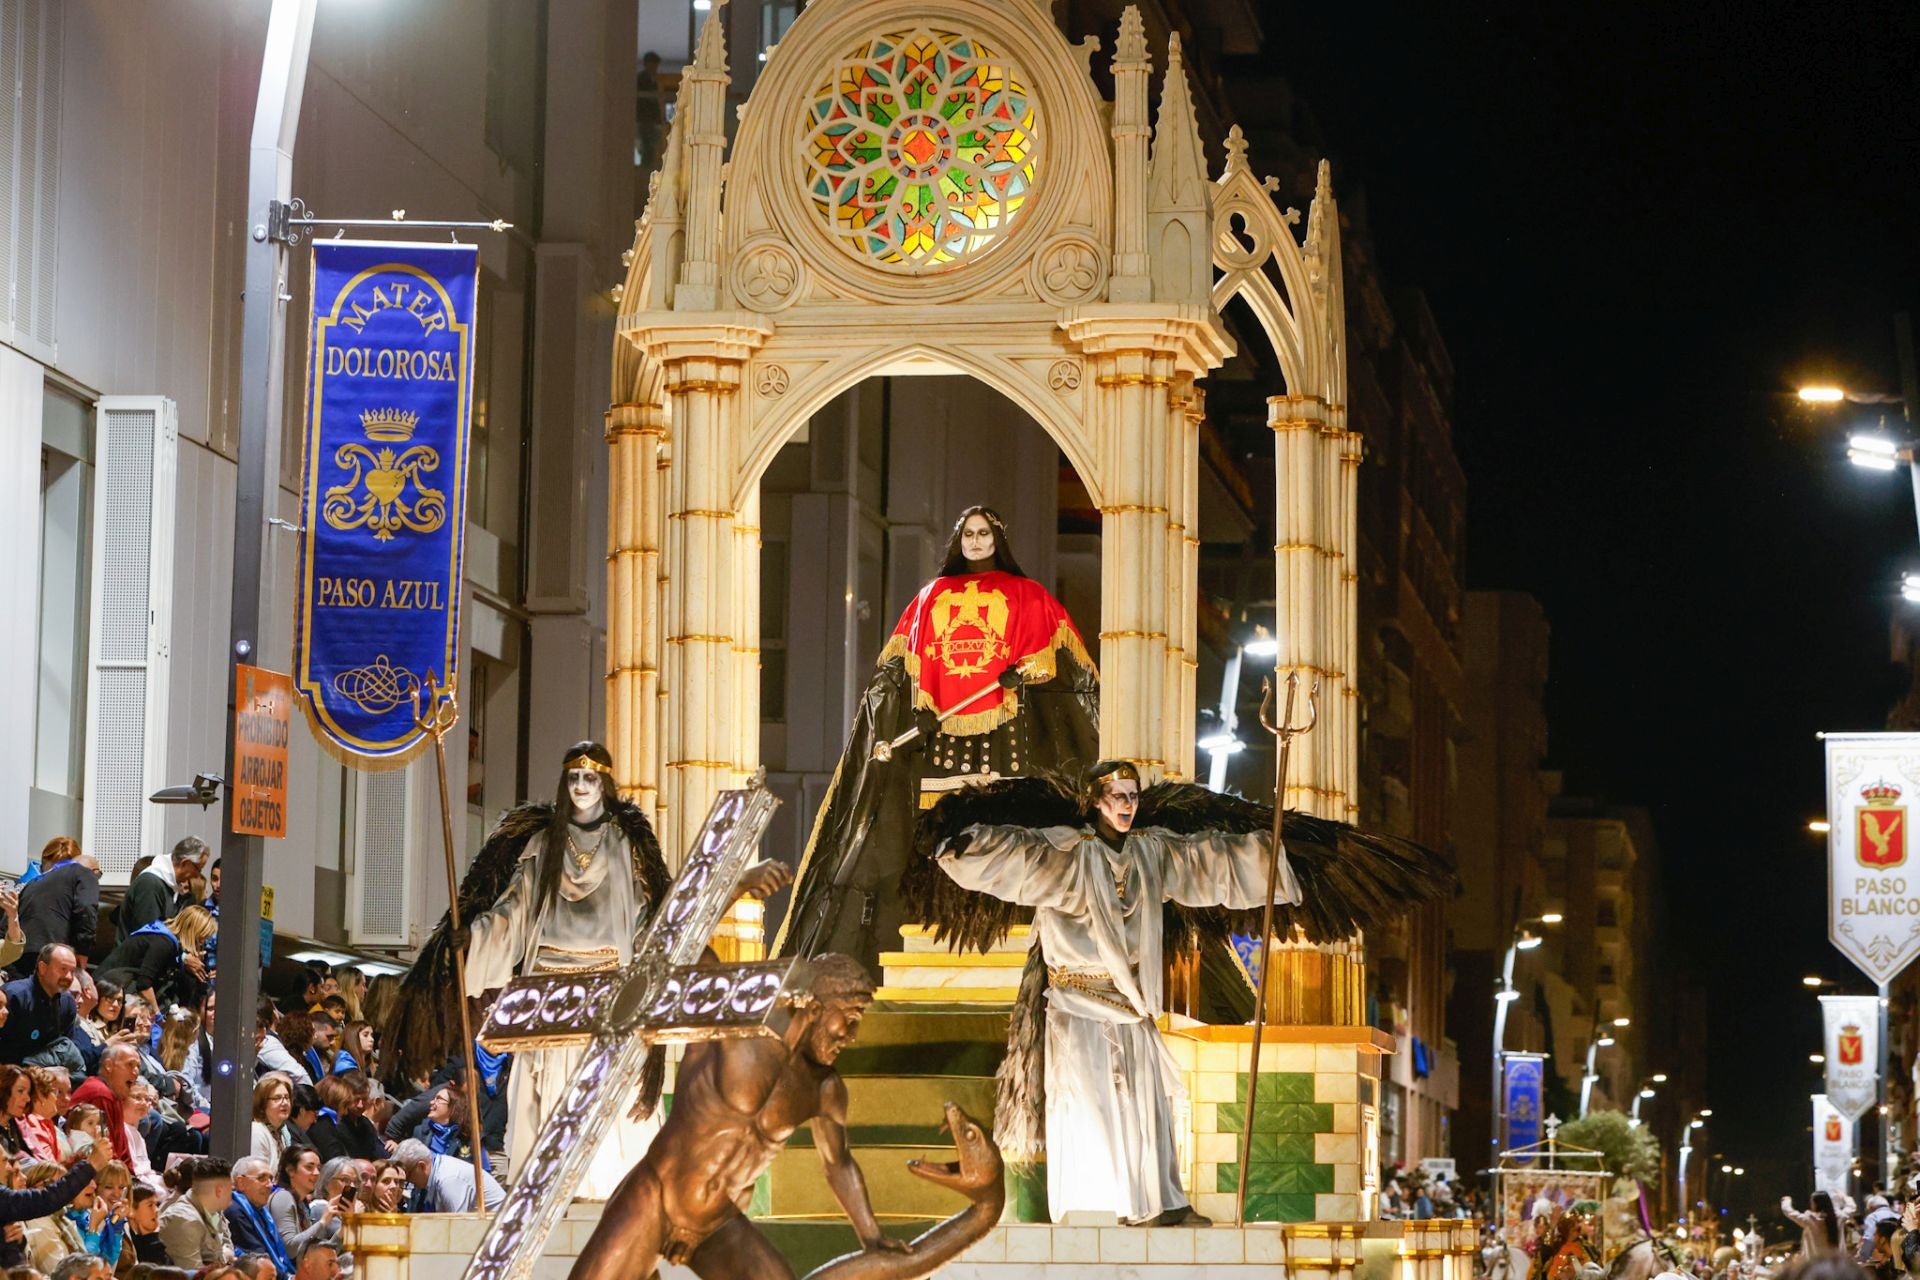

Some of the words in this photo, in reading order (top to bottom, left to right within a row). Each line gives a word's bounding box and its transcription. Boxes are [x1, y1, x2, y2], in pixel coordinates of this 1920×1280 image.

[341, 282, 446, 338] MATER
[326, 346, 456, 382] DOLOROSA
[318, 578, 376, 607] PASO
[380, 580, 444, 610] AZUL
[238, 711, 289, 749] PROHIBIDO
[240, 755, 283, 790] ARROJAR
[239, 798, 281, 832] OBJETOS
[1855, 878, 1906, 895] PASO
[1841, 898, 1920, 916] BLANCO
